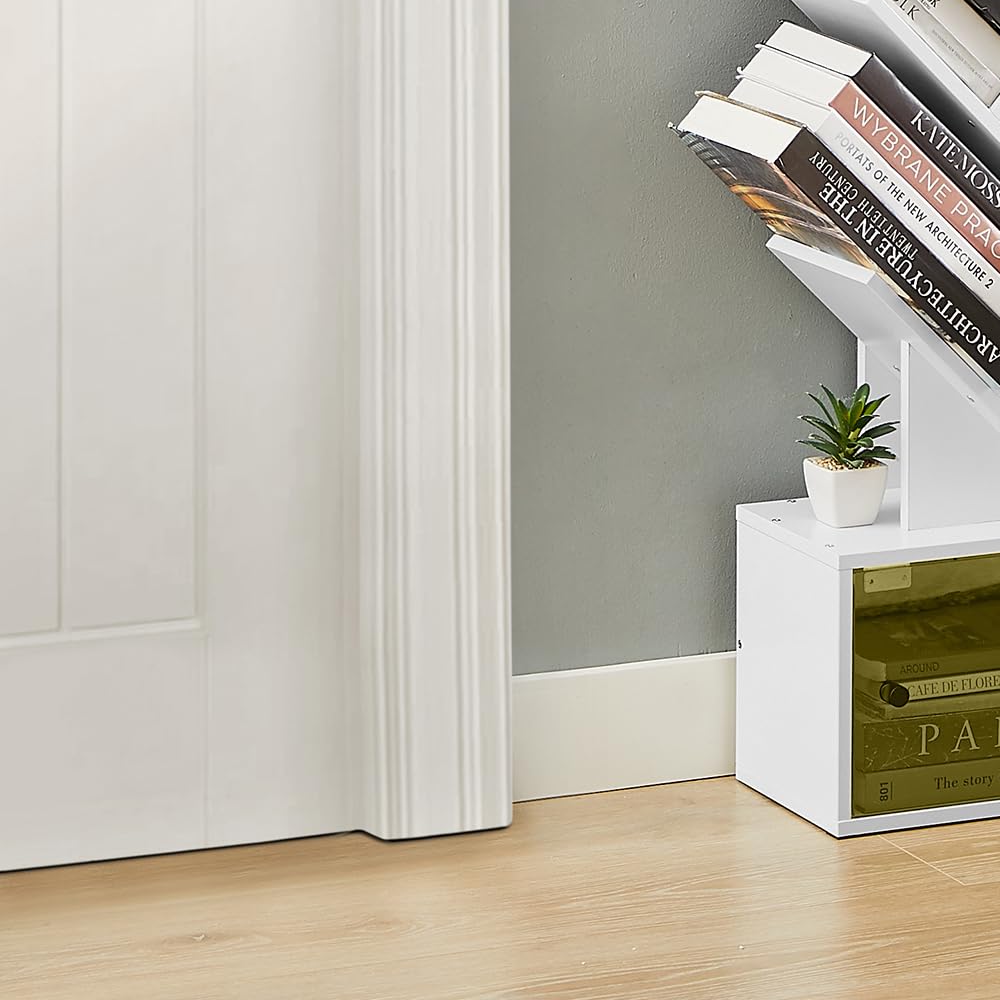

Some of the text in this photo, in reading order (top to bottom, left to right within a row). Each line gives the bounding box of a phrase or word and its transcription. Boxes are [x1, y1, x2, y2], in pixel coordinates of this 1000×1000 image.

[852, 96, 953, 205] WYBRANE
[910, 109, 961, 165] KATE
[808, 151, 919, 261] TWENTIETH CENTURY
[818, 175, 868, 227] THE
[833, 132, 995, 290] PORTATS OF THE NEW ARCHITECTURE 2
[852, 212, 887, 248] IN
[900, 661, 940, 675] AROUND
[907, 675, 1000, 698] CAFE DE FLORE
[879, 781, 889, 802] 801
[934, 776, 959, 790] The
[962, 772, 994, 789] story
